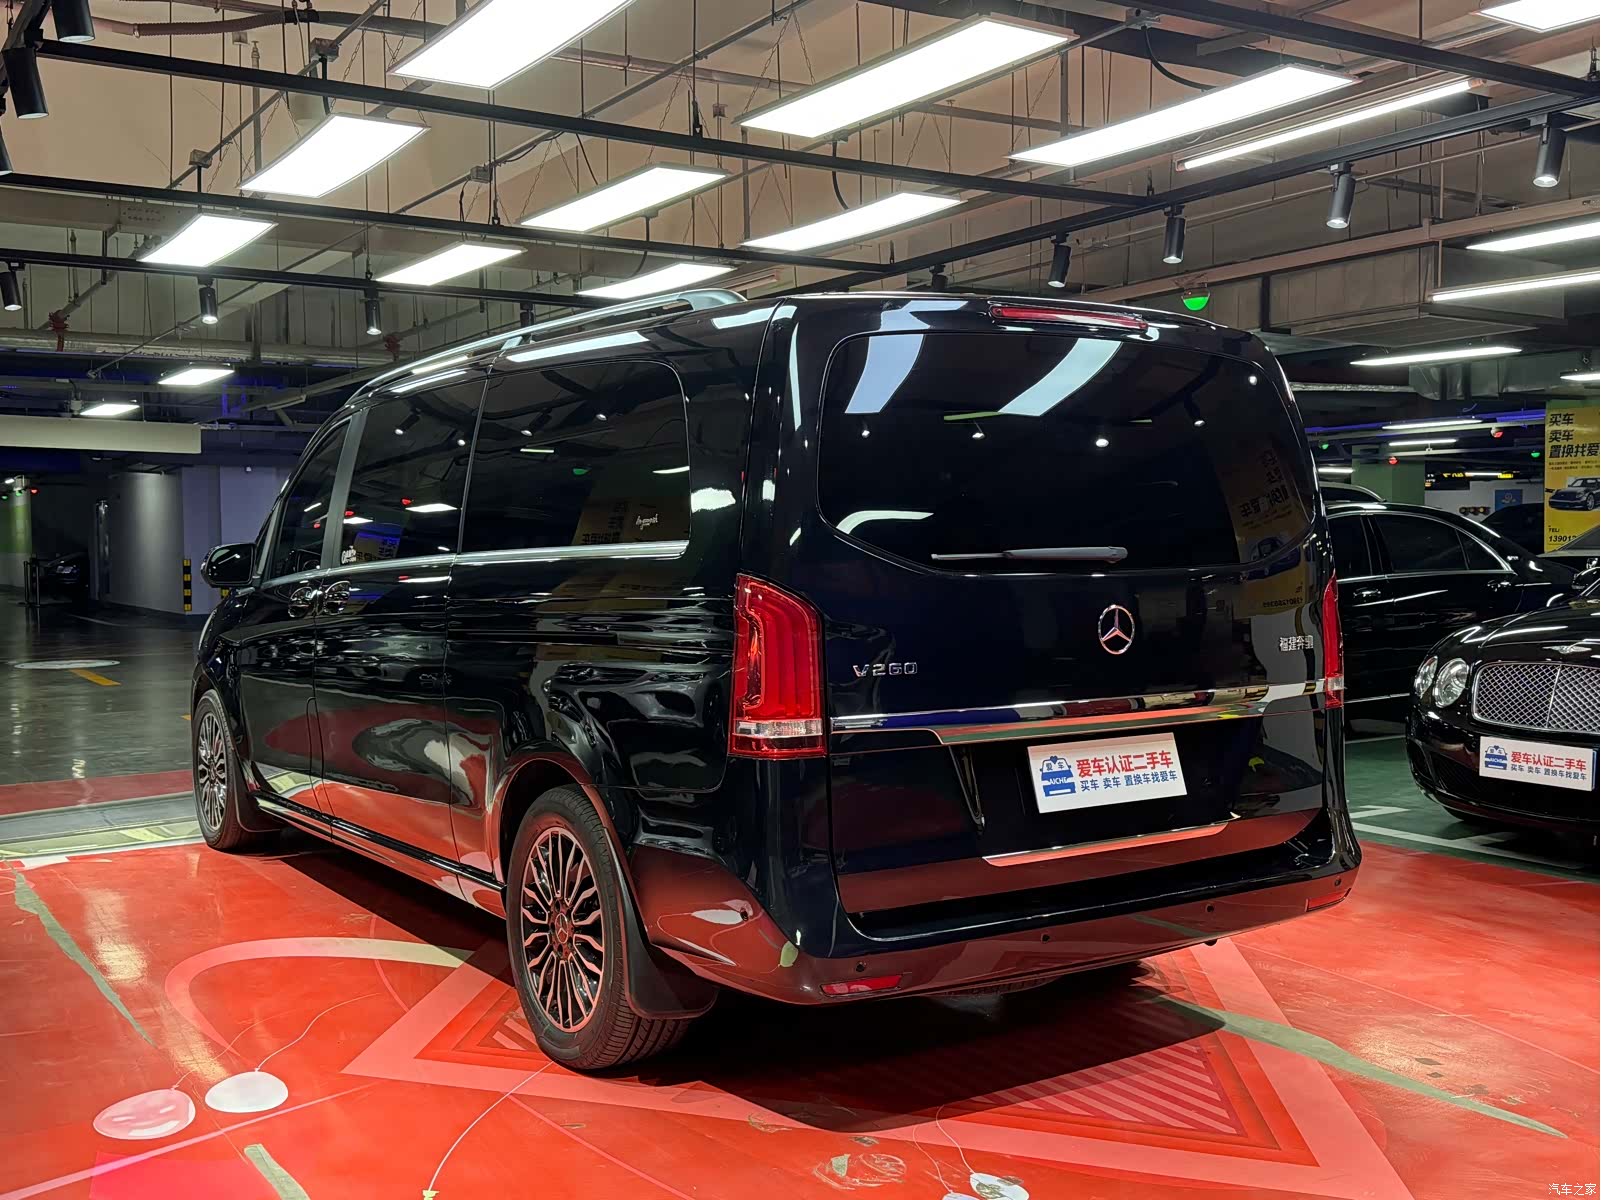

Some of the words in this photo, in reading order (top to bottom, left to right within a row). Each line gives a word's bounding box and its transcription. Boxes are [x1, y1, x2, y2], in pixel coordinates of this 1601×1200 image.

[1549, 412, 1575, 426] 买车
[1548, 429, 1575, 443] 卖车
[853, 662, 918, 677] V260
[1076, 750, 1174, 778] 爱车认证二手车
[1511, 751, 1587, 772] 爱车认证二手车
[1080, 778, 1100, 792] 买车
[1103, 776, 1122, 790] 卖车
[1124, 770, 1178, 787] 置换车找爱车
